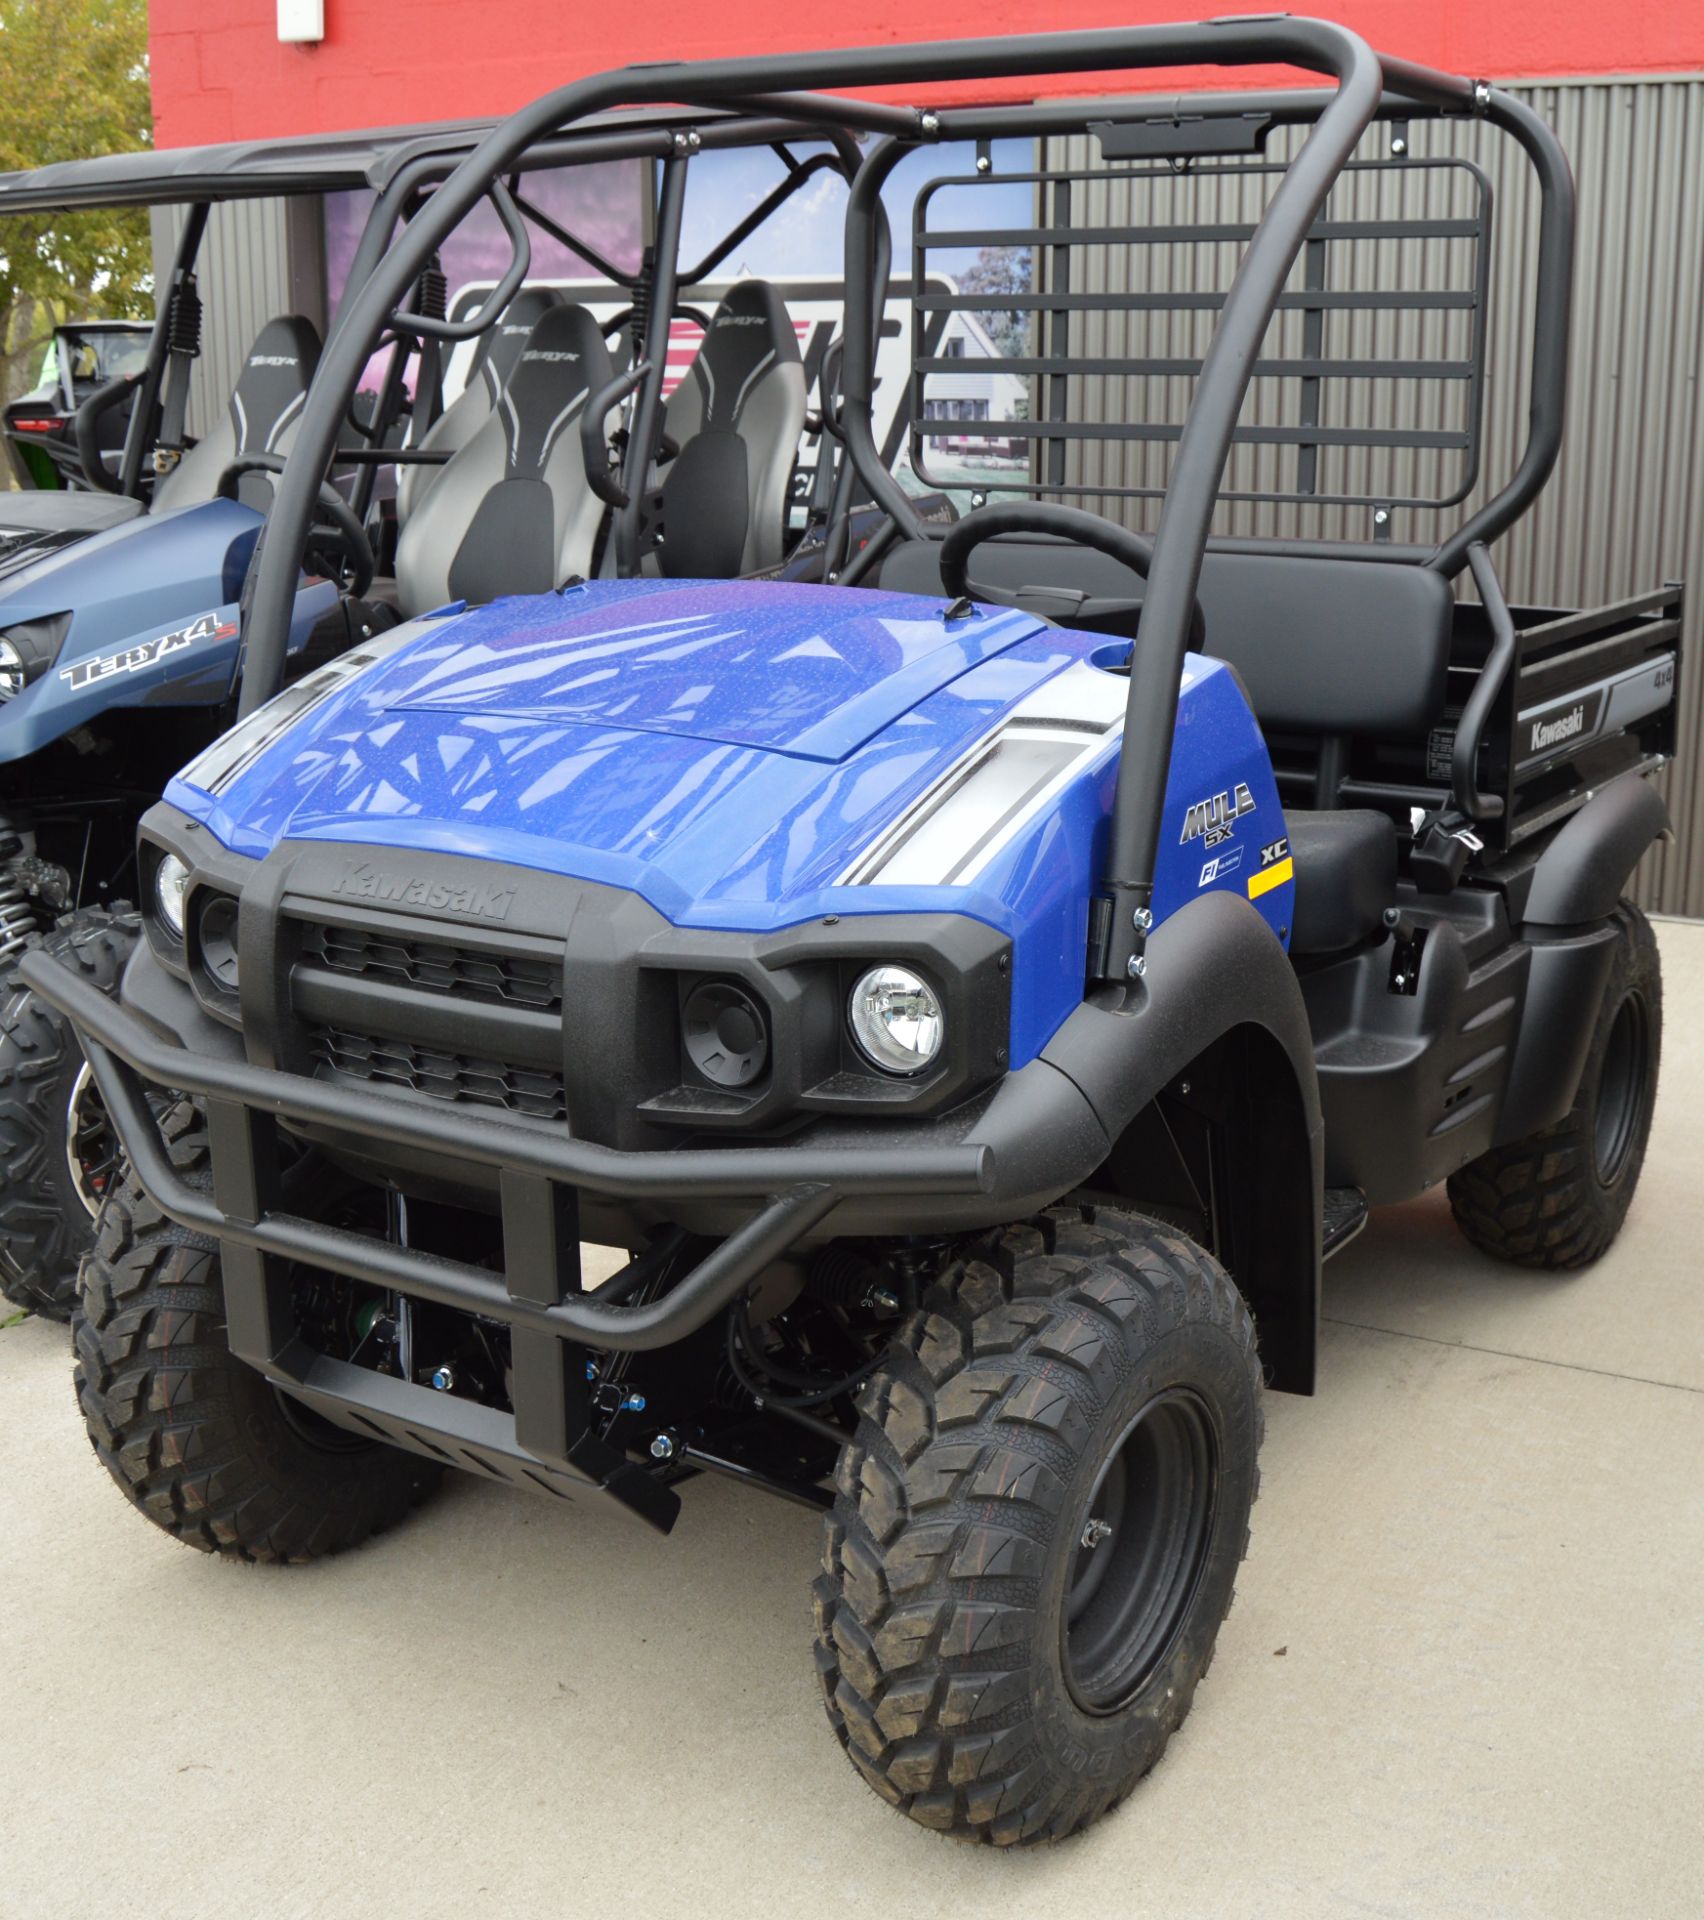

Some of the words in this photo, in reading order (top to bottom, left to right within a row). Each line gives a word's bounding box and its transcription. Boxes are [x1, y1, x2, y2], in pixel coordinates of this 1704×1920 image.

[1531, 704, 1584, 751] Kawasaki
[1179, 782, 1256, 845] MULE
[1204, 820, 1235, 850] SX
[1260, 837, 1288, 866] XC
[331, 859, 519, 921] Kawasaki
